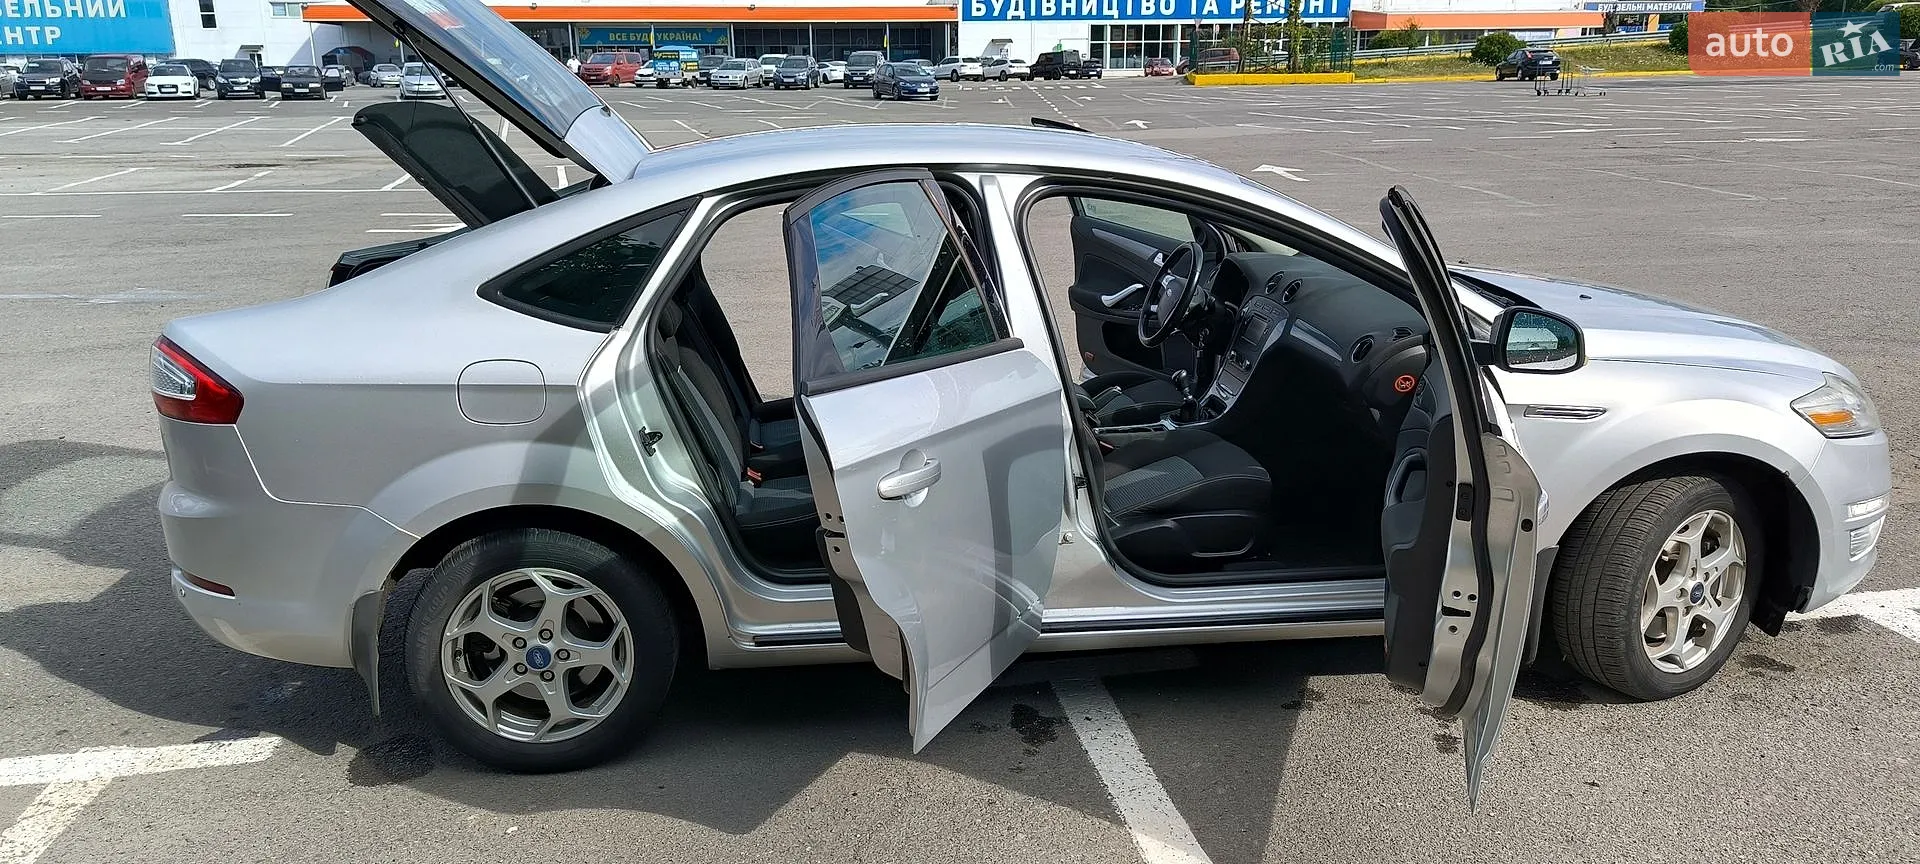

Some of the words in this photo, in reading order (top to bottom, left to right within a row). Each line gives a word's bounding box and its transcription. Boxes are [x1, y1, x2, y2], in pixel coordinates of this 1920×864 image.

[1646, 3, 1692, 11] МАТЕРІАЛИ
[0, 26, 61, 45] НТР
[609, 32, 628, 41] ВСЕ
[629, 32, 651, 42] БУД
[656, 31, 702, 41] УКРАЇНА!
